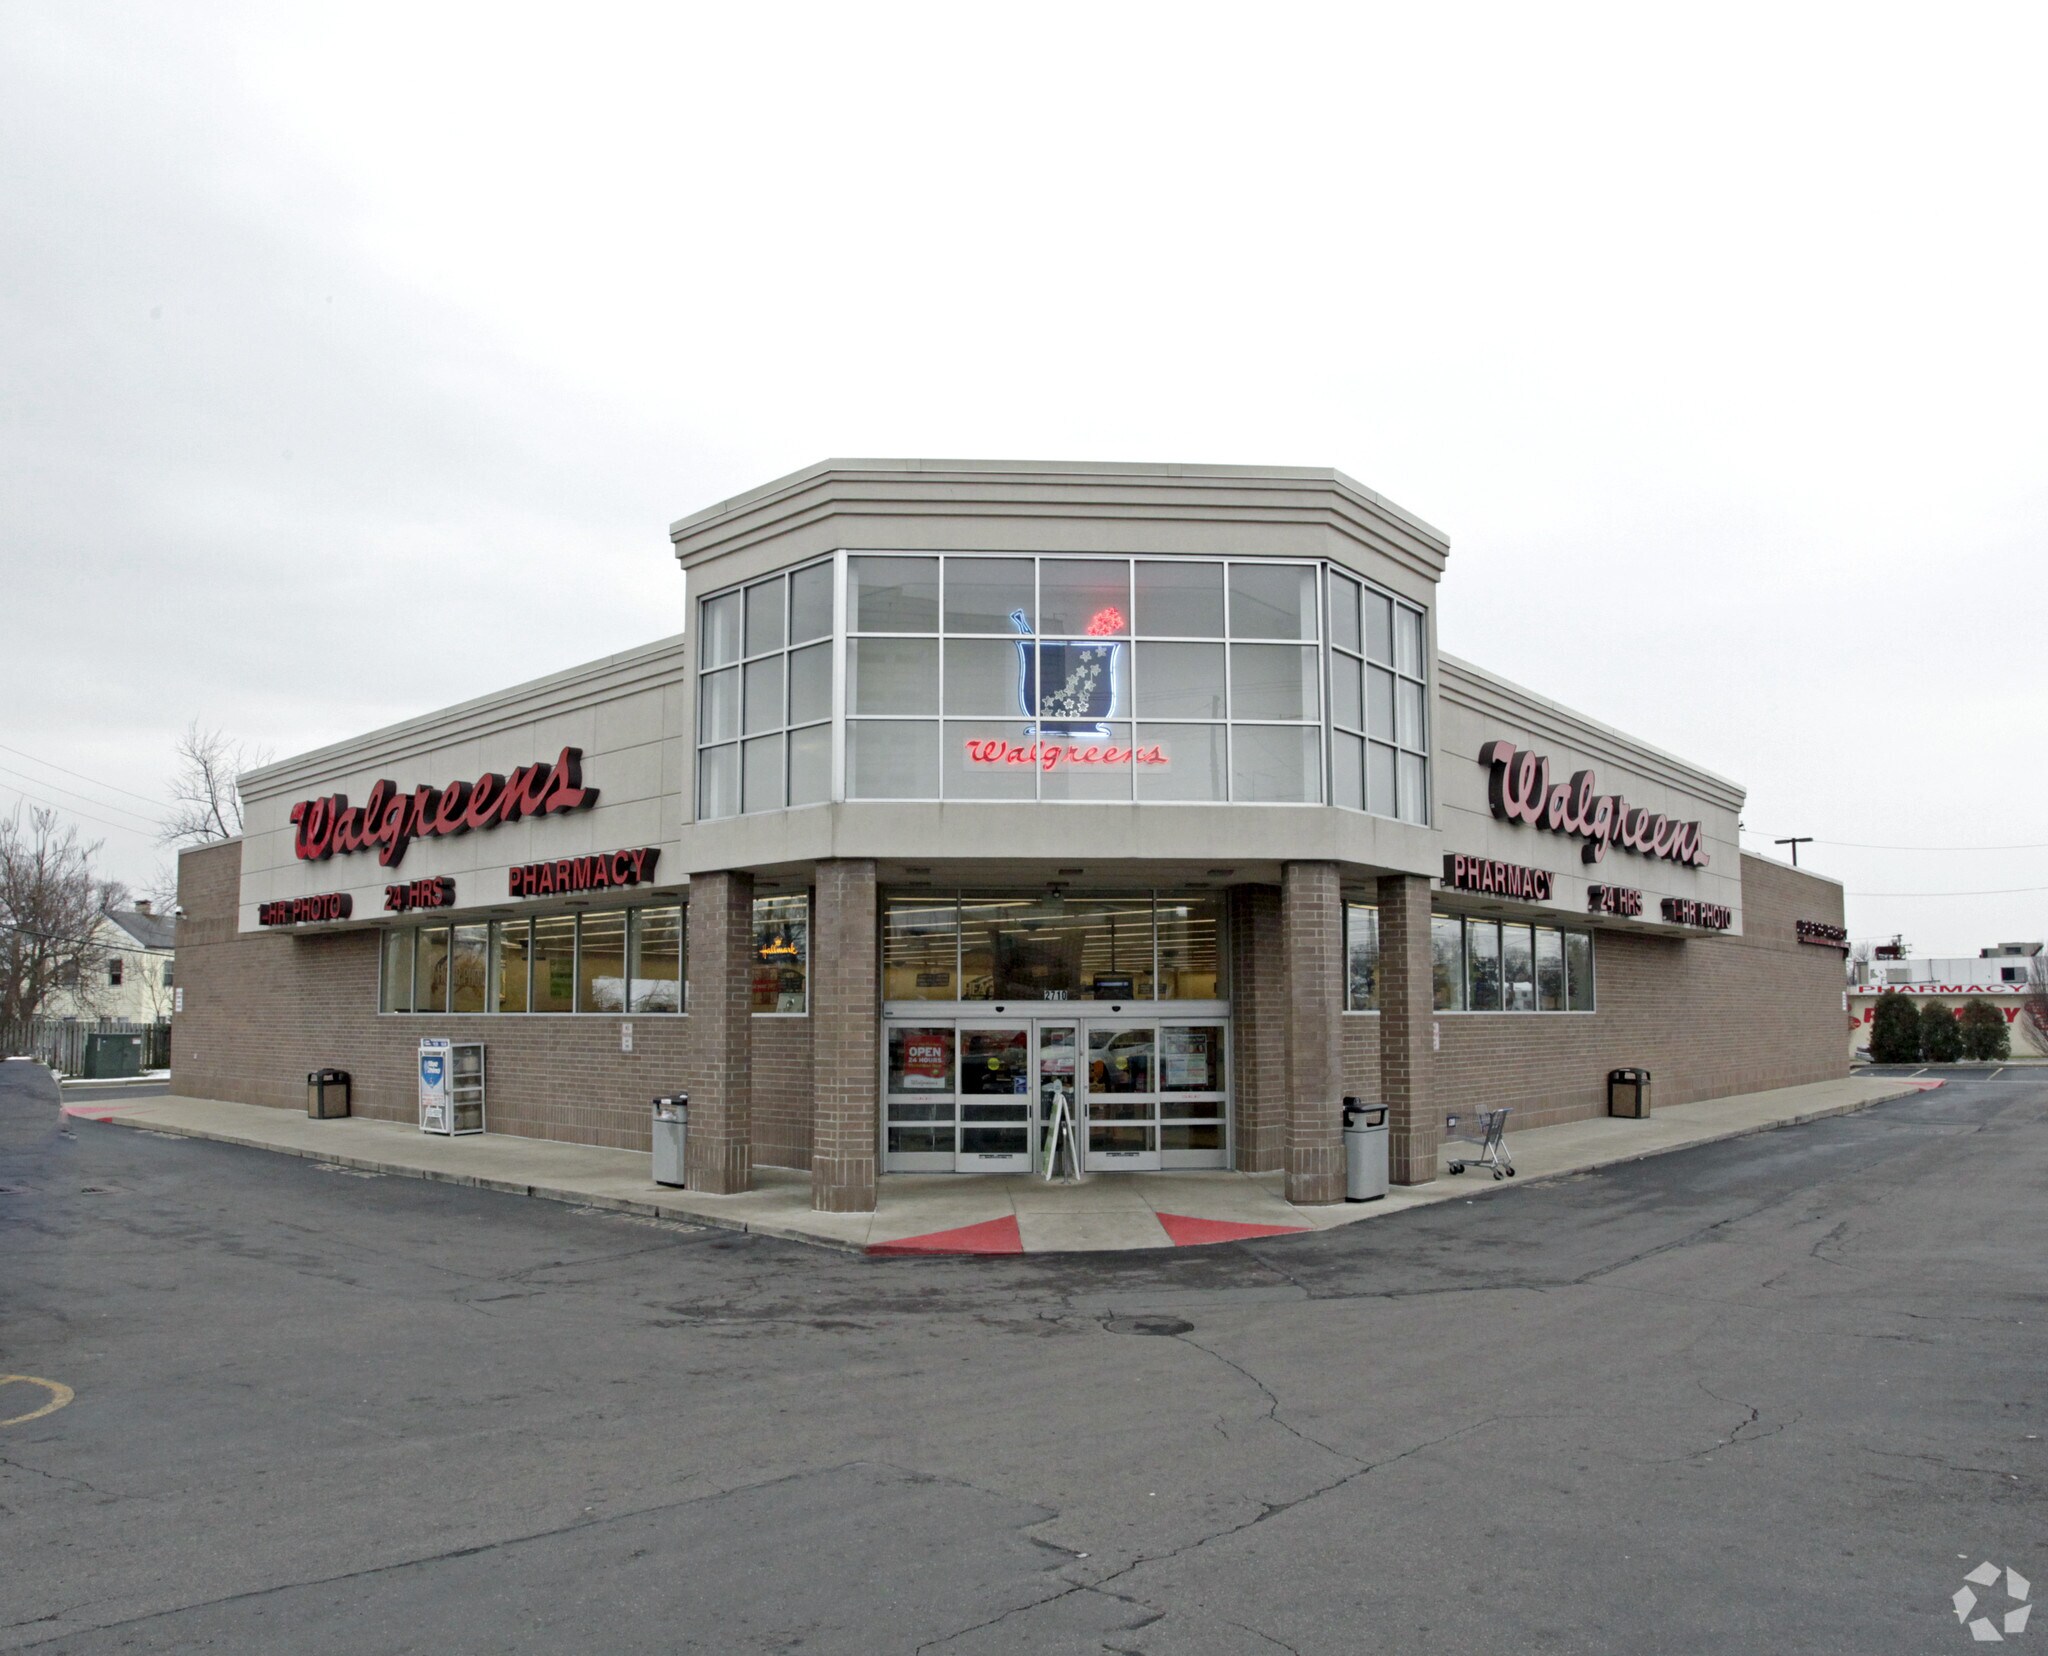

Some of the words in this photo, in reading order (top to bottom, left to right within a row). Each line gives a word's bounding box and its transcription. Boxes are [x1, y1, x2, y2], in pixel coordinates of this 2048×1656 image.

[965, 740, 1169, 770] Walgreens
[290, 746, 594, 868] Walgreens
[1485, 740, 1710, 867] Walgreens
[508, 848, 653, 897] PHARMACY
[1450, 854, 1555, 900] PHARMACY
[293, 893, 346, 923] PHOTO
[384, 885, 402, 911] 24
[409, 876, 449, 908] HRS
[1596, 884, 1615, 911] 24
[1620, 889, 1643, 916] HRS
[1669, 899, 1696, 925] 1-HR
[1701, 902, 1733, 929] PHOTO
[759, 943, 798, 959] Hallmark
[1045, 991, 1067, 1000] 2710
[1858, 985, 2025, 993] PHARMACY
[909, 1046, 942, 1057] OPEN
